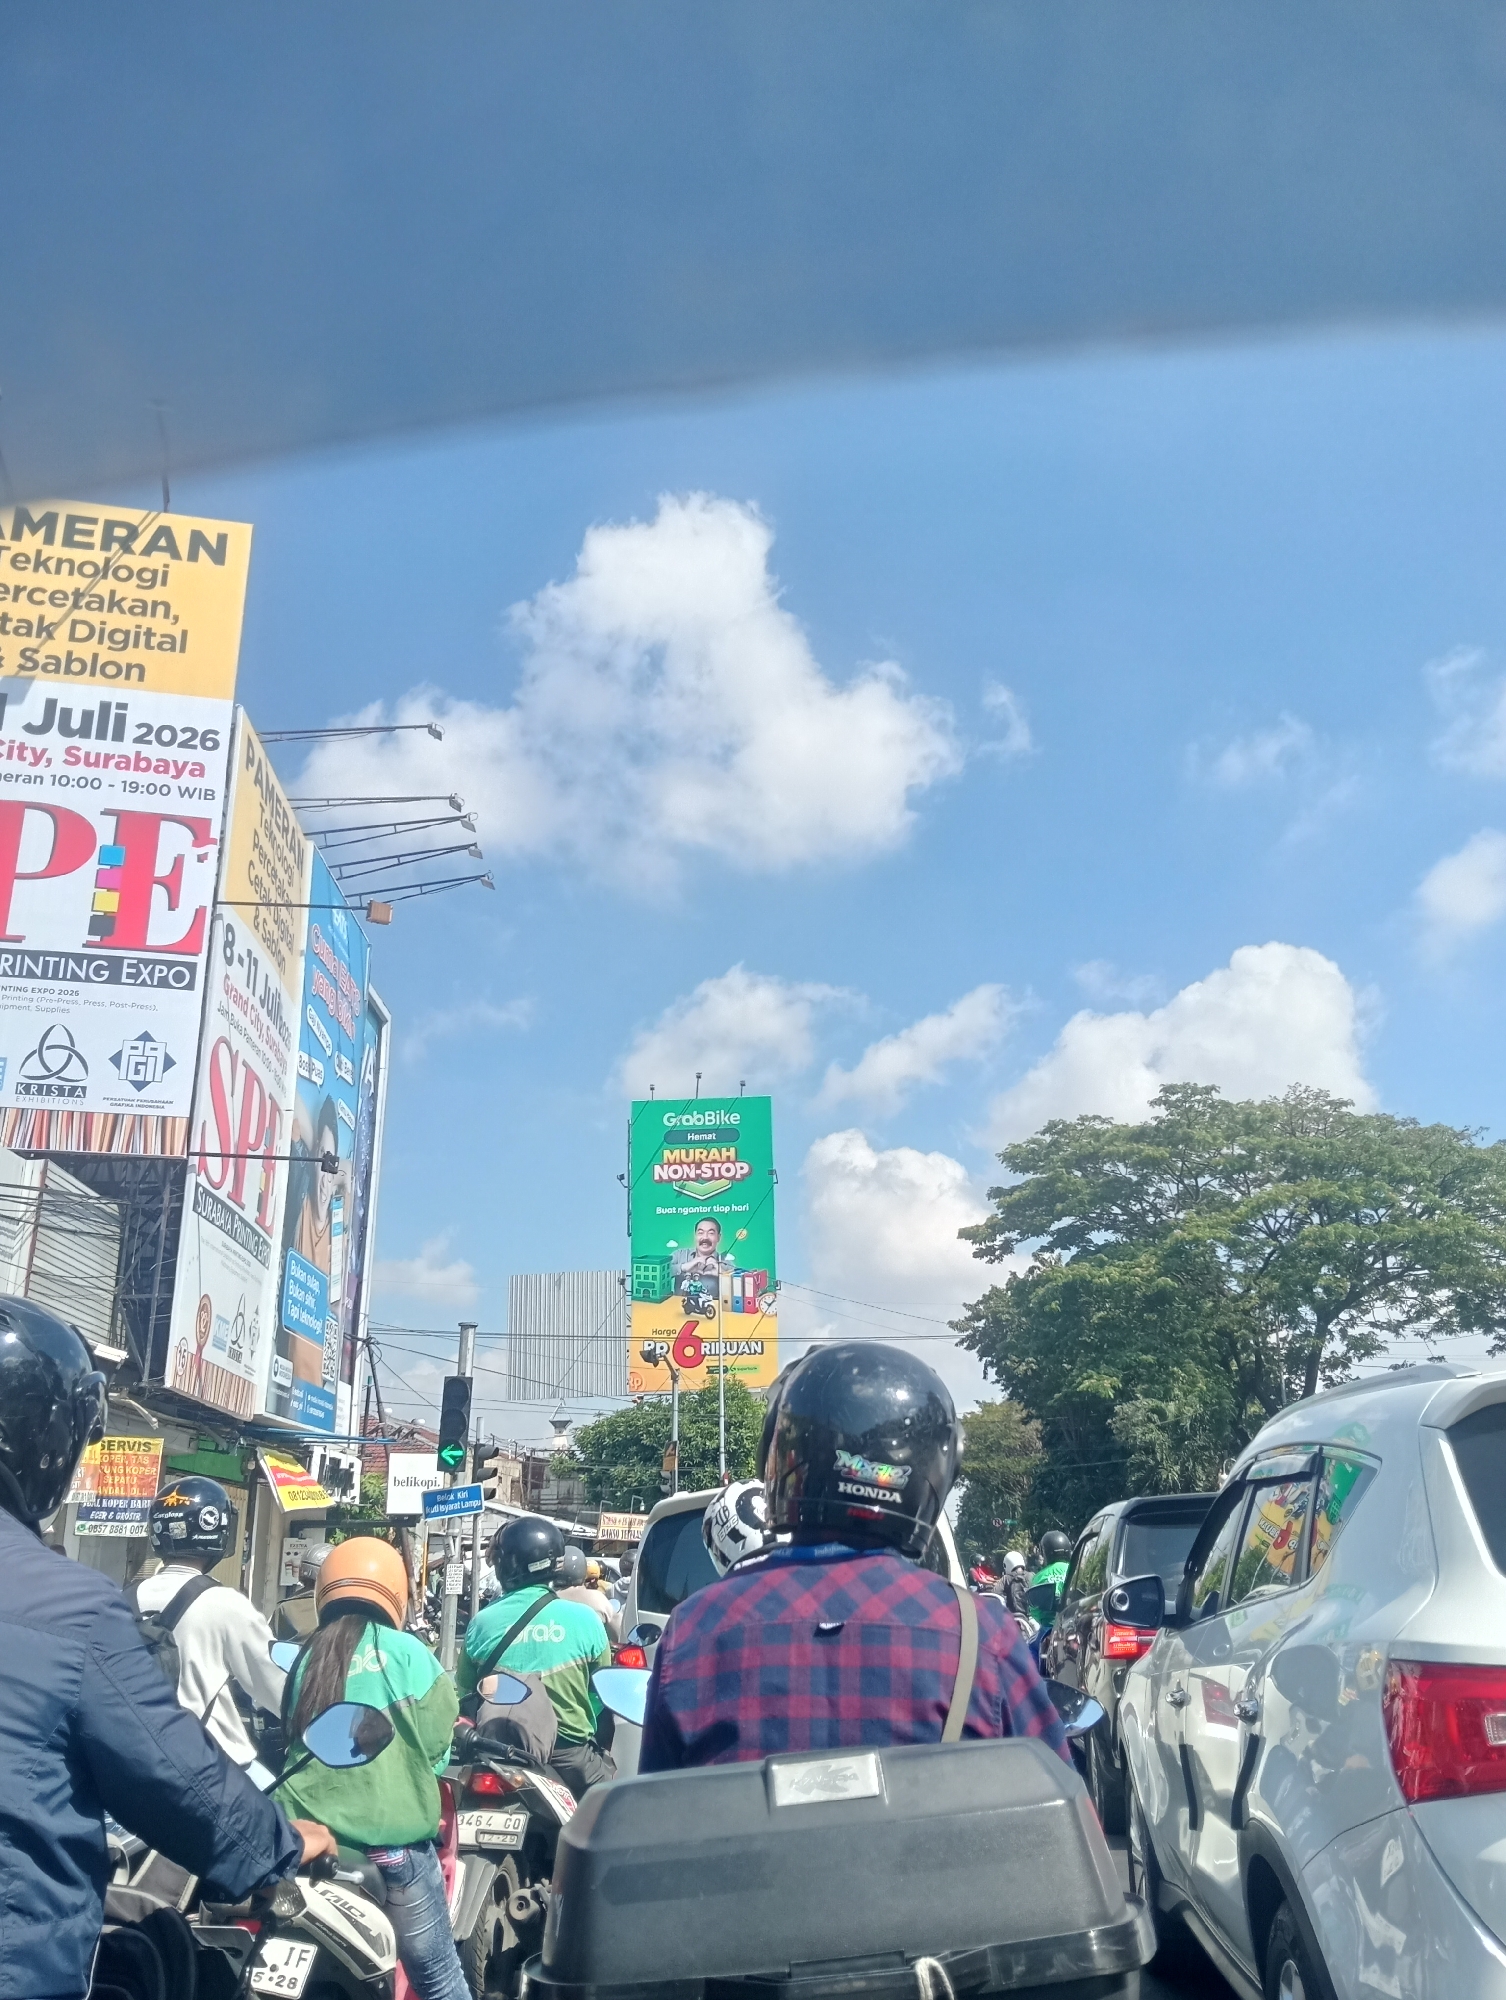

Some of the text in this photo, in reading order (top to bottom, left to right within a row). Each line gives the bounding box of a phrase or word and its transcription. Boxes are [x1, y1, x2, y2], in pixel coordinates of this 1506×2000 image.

[0, 506, 229, 566] MERAN
[68, 619, 189, 654] Digital
[17, 647, 146, 682] Sablon
[22, 697, 129, 743] Juli
[132, 722, 221, 751] 2026
[62, 745, 206, 780] Surabaya
[0, 772, 44, 786] eran
[51, 774, 102, 790] 10:00
[121, 780, 171, 797] 19:00
[178, 785, 216, 801] WIB
[245, 733, 304, 878] PAMERAN
[259, 801, 295, 888] Teknologi
[252, 828, 295, 926] Percetakan,
[248, 860, 295, 956] Cetak Digital
[254, 905, 286, 976] & Sablon
[223, 923, 236, 966] 8
[245, 948, 259, 998] 11
[259, 973, 283, 1030] Juli
[31, 987, 55, 995] EXPO
[35, 1005, 71, 1014] Supplies
[217, 1000, 230, 1021] Jam
[230, 1012, 243, 1036] Buka
[223, 973, 288, 1077] Grand City, Surabaya
[15, 1096, 85, 1106] EXHIBITIONS
[17, 1083, 84, 1099] KRISTA
[663, 1109, 741, 1127] GrabBike
[198, 1035, 284, 1239] SPE
[687, 1132, 717, 1141] Hemat
[663, 1147, 736, 1163] MURAH
[653, 1162, 750, 1181] NON-STOP
[197, 1186, 232, 1235] SURABAYA
[656, 1203, 750, 1215] Buat ngantor tiap hari
[290, 1259, 307, 1284] Bukan
[288, 1279, 306, 1303] Bukan
[287, 1298, 300, 1321] Tapi
[651, 1328, 677, 1337] Harga
[672, 1320, 706, 1368] 6
[700, 1339, 764, 1357] RIBUAN
[101, 1439, 152, 1453] SERVIS
[125, 1466, 157, 1476] KOPER
[131, 1455, 150, 1464] TAS
[103, 1474, 138, 1485] SEPATU
[393, 1476, 441, 1490] belikopi.
[436, 1490, 469, 1502] Belok Kiri
[837, 1481, 903, 1504] HONDA
[425, 1499, 481, 1514] Ikuti Isyarat Lampu
